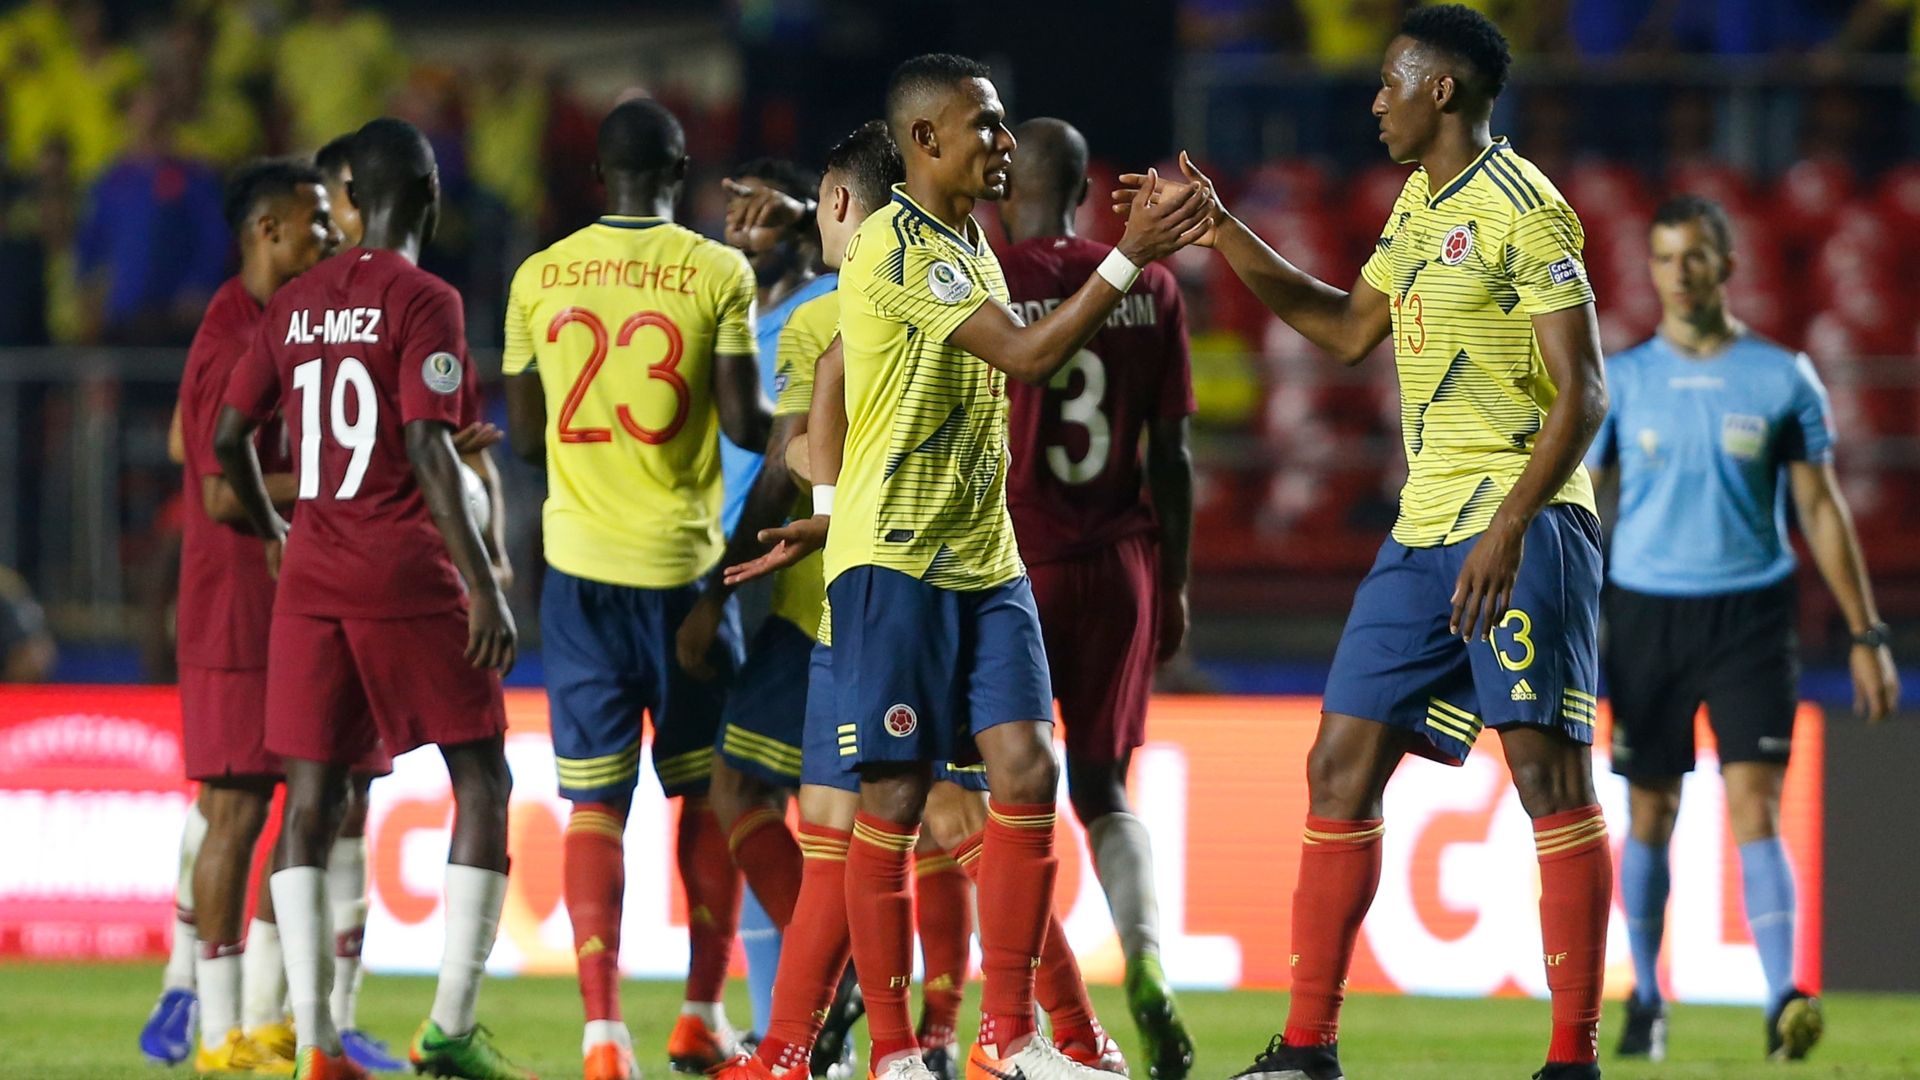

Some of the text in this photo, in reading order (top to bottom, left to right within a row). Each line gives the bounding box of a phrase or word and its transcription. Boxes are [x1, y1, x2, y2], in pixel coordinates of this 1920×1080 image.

[540, 259, 699, 295] D.SANCHEZ
[284, 307, 382, 345] AL-MOEZ
[1393, 292, 1427, 356] 13
[546, 306, 691, 446] 23
[291, 355, 379, 501] 19
[1046, 346, 1111, 486] 3
[1510, 692, 1537, 702] adidas
